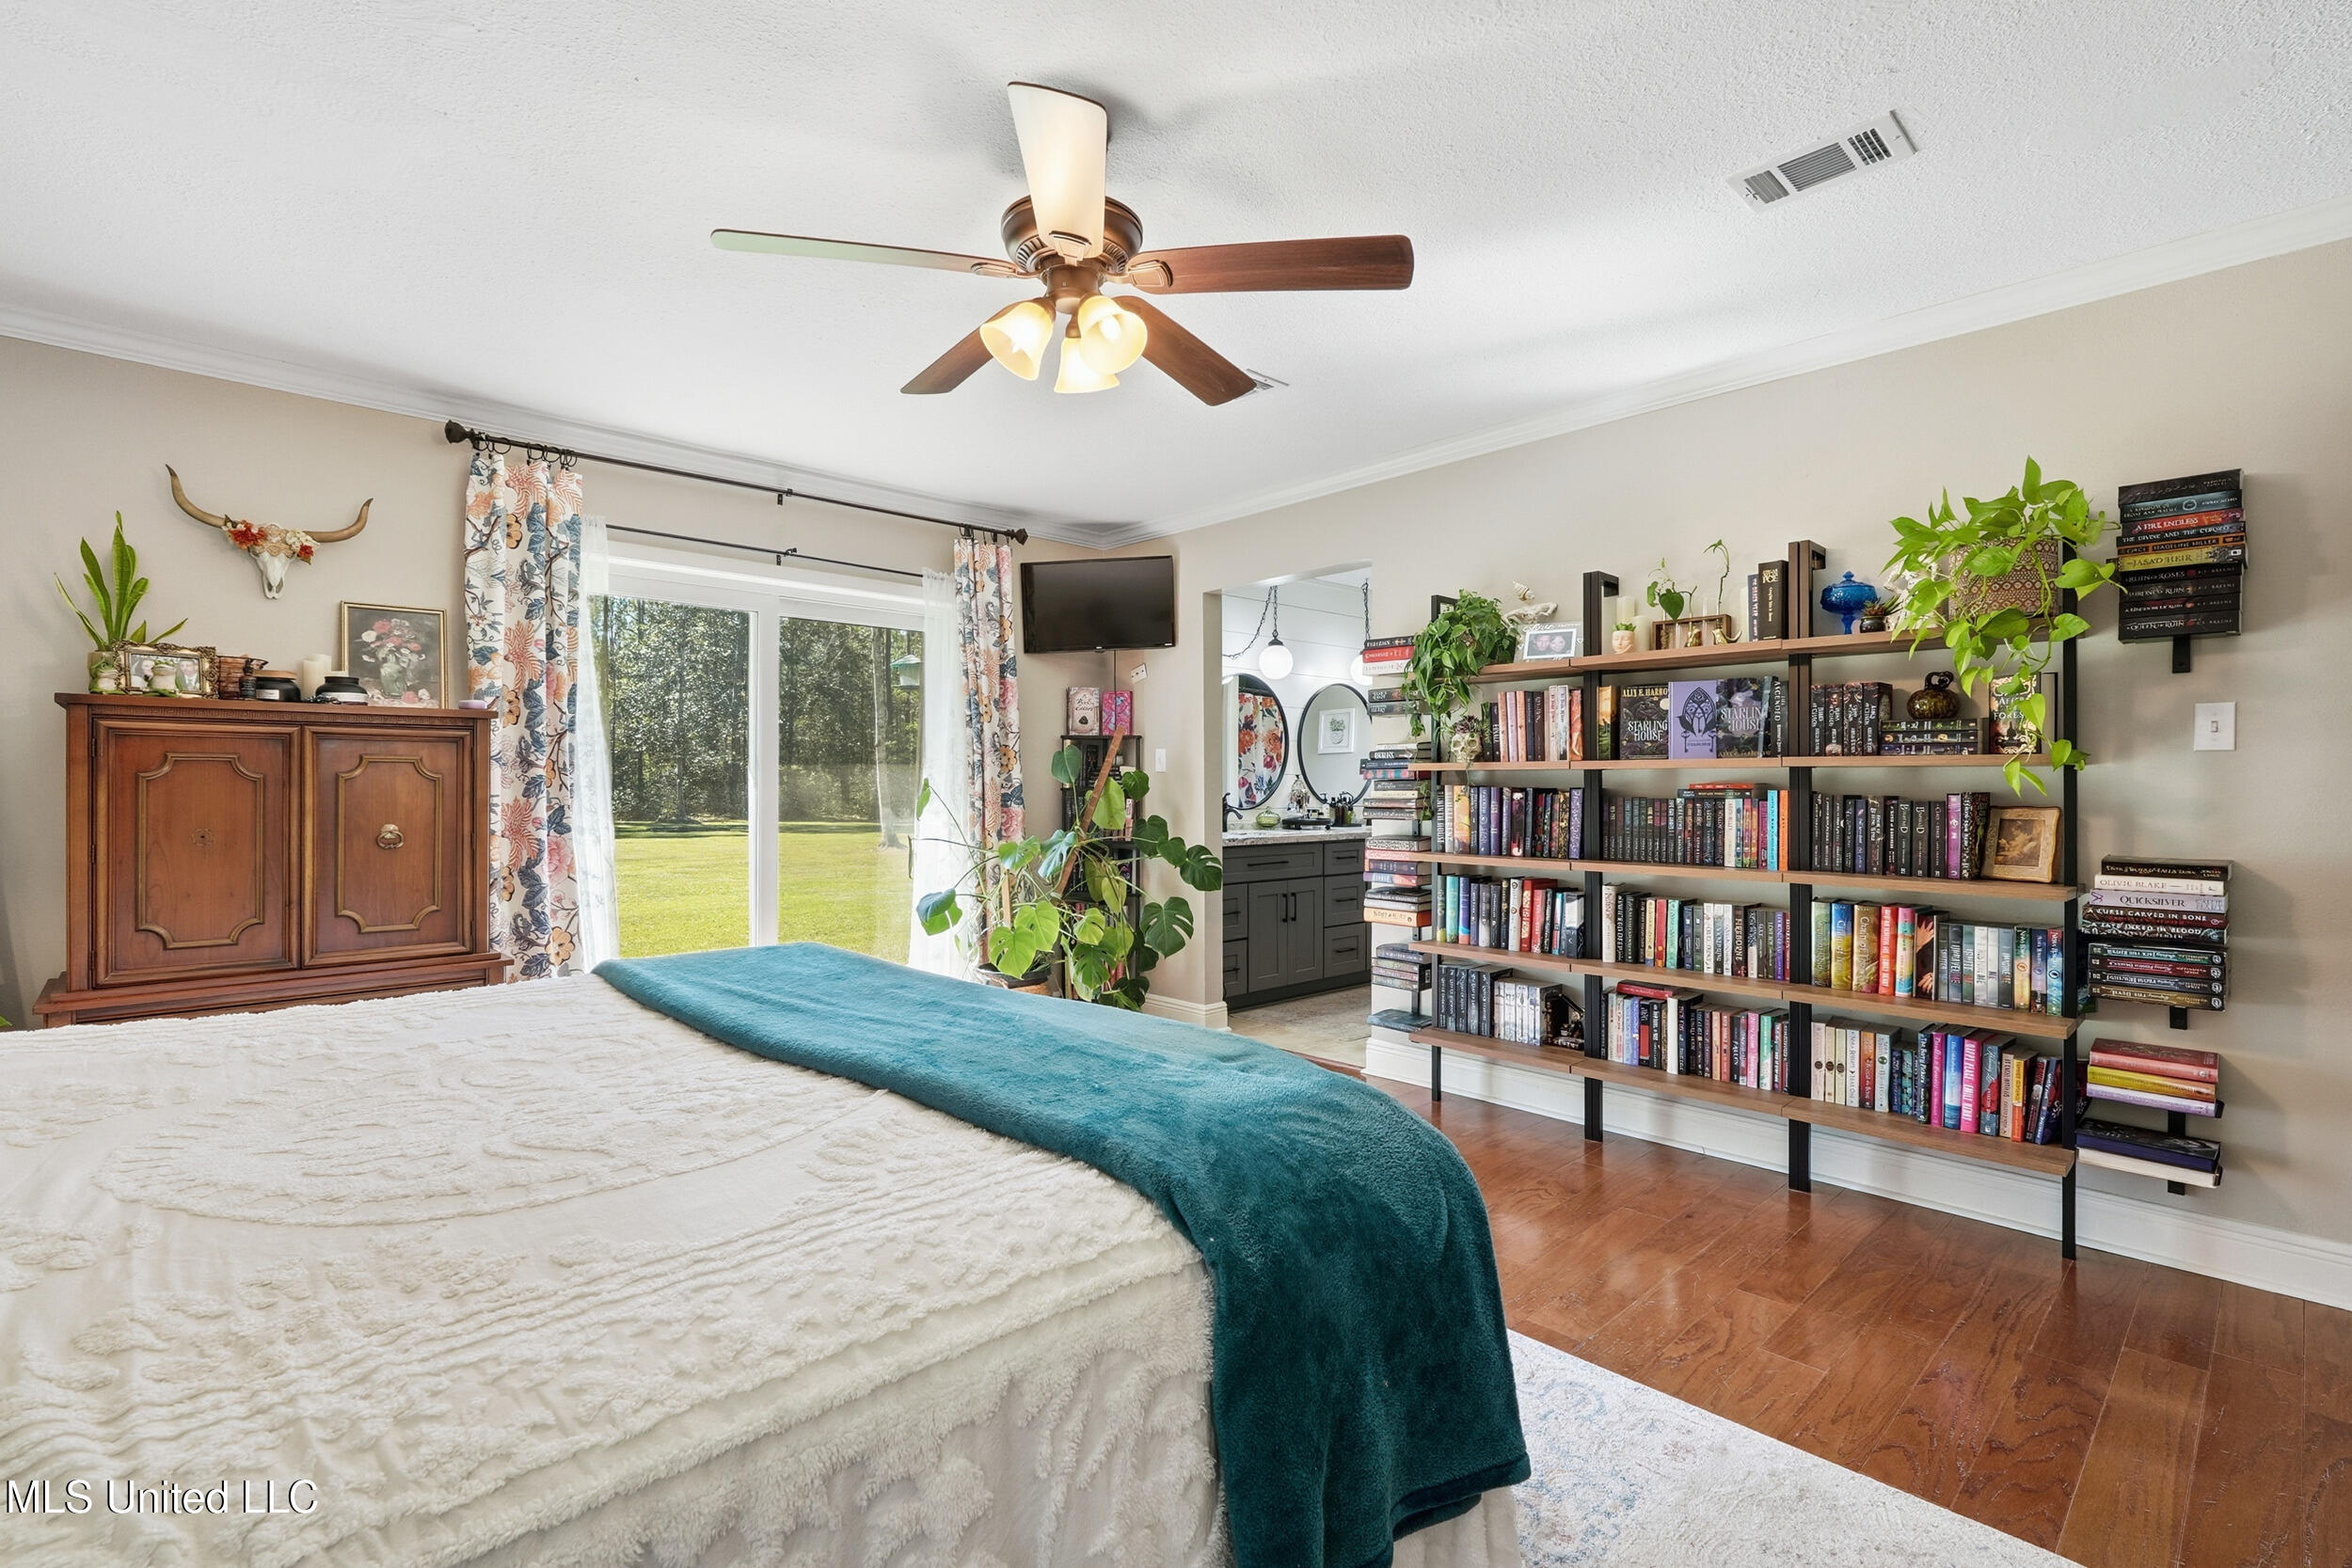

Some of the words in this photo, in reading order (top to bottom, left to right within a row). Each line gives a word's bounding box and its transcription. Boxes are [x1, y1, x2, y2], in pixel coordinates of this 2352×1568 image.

[2144, 521, 2162, 530] FIRE
[2164, 516, 2199, 529] ENDLESS
[2137, 533, 2161, 542] DIVINE
[2163, 531, 2180, 539] AND
[2153, 542, 2189, 550] MADELINE
[2192, 538, 2217, 546] MILLER
[2166, 554, 2193, 563] HEIR
[1762, 575, 1779, 583] POE
[2129, 575, 2151, 583] RUIN
[2158, 571, 2185, 580] ROSES
[2165, 587, 2185, 595] RUIN
[2165, 620, 2185, 628] RUIN
[1645, 688, 1668, 696] HARRO
[1994, 711, 2024, 721] FORES
[1628, 719, 1668, 731] STARLING
[1633, 730, 1663, 742] HOUSE
[2120, 895, 2185, 908] QUICKSILVER
[2097, 908, 2124, 916] CURSE
[1860, 916, 1870, 940] Chain
[1734, 918, 1743, 961] FIREBORNE
[1836, 946, 1845, 955] of
[1860, 942, 1868, 952] of
[1950, 944, 1961, 973] UNRAVEL
[1963, 948, 1973, 971] IGNITE
[2001, 953, 2010, 975] IMAGINE
